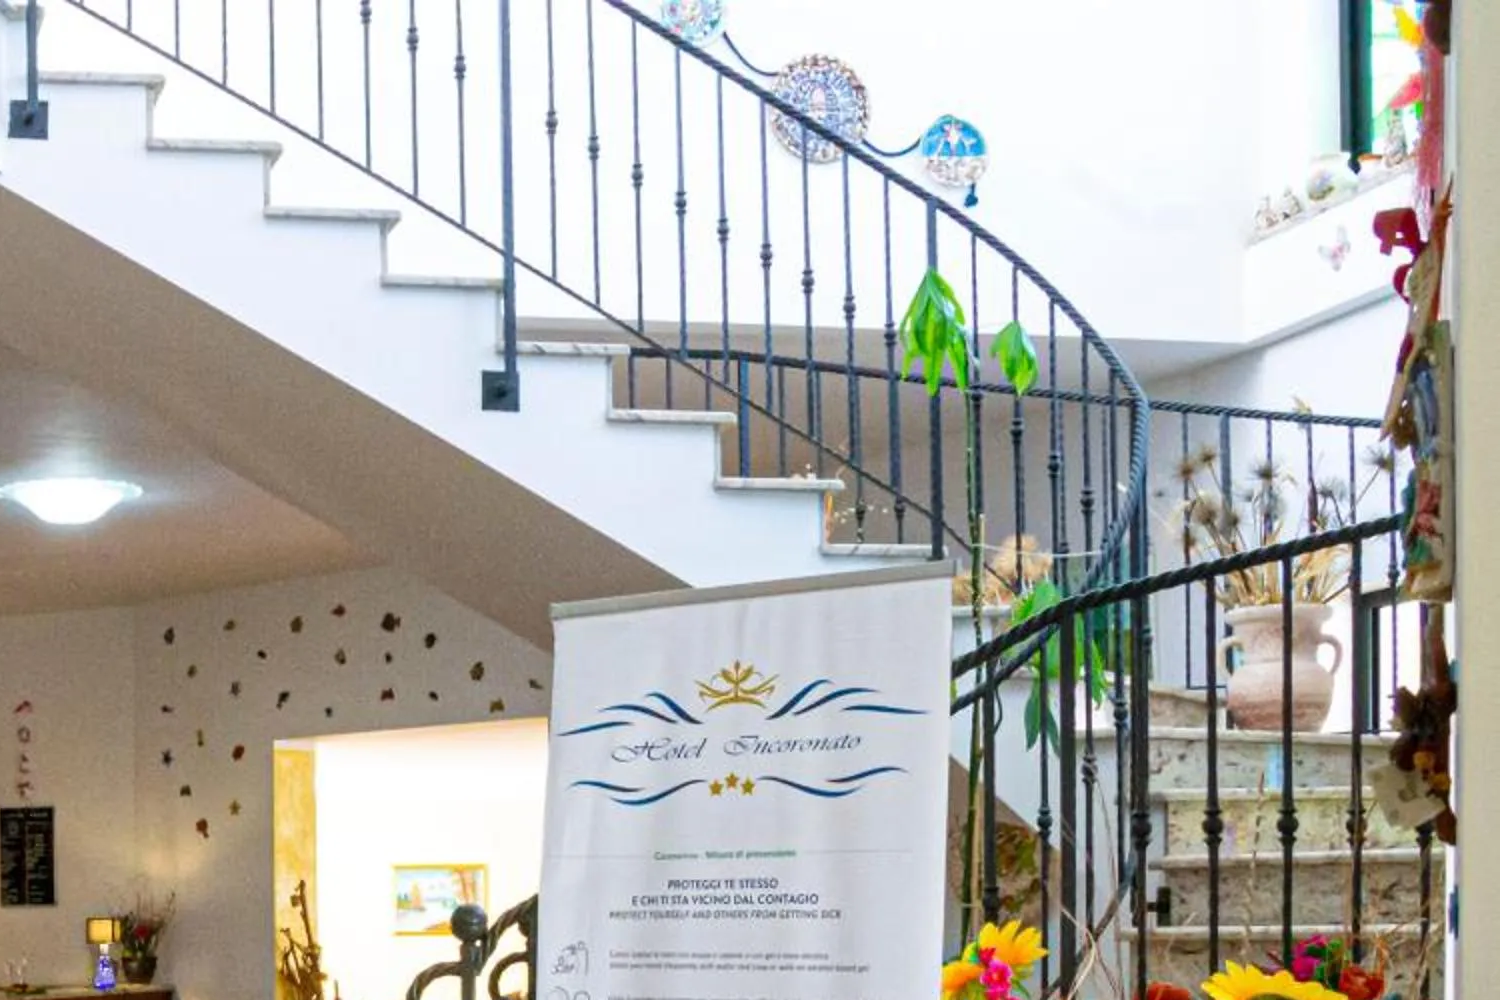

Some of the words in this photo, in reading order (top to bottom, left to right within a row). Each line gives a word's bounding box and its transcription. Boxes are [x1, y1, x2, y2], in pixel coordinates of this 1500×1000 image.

[610, 736, 707, 764] Hotel
[723, 732, 863, 758] Incoronato
[739, 877, 780, 889] STESSO
[757, 893, 820, 905] CONTAGIO
